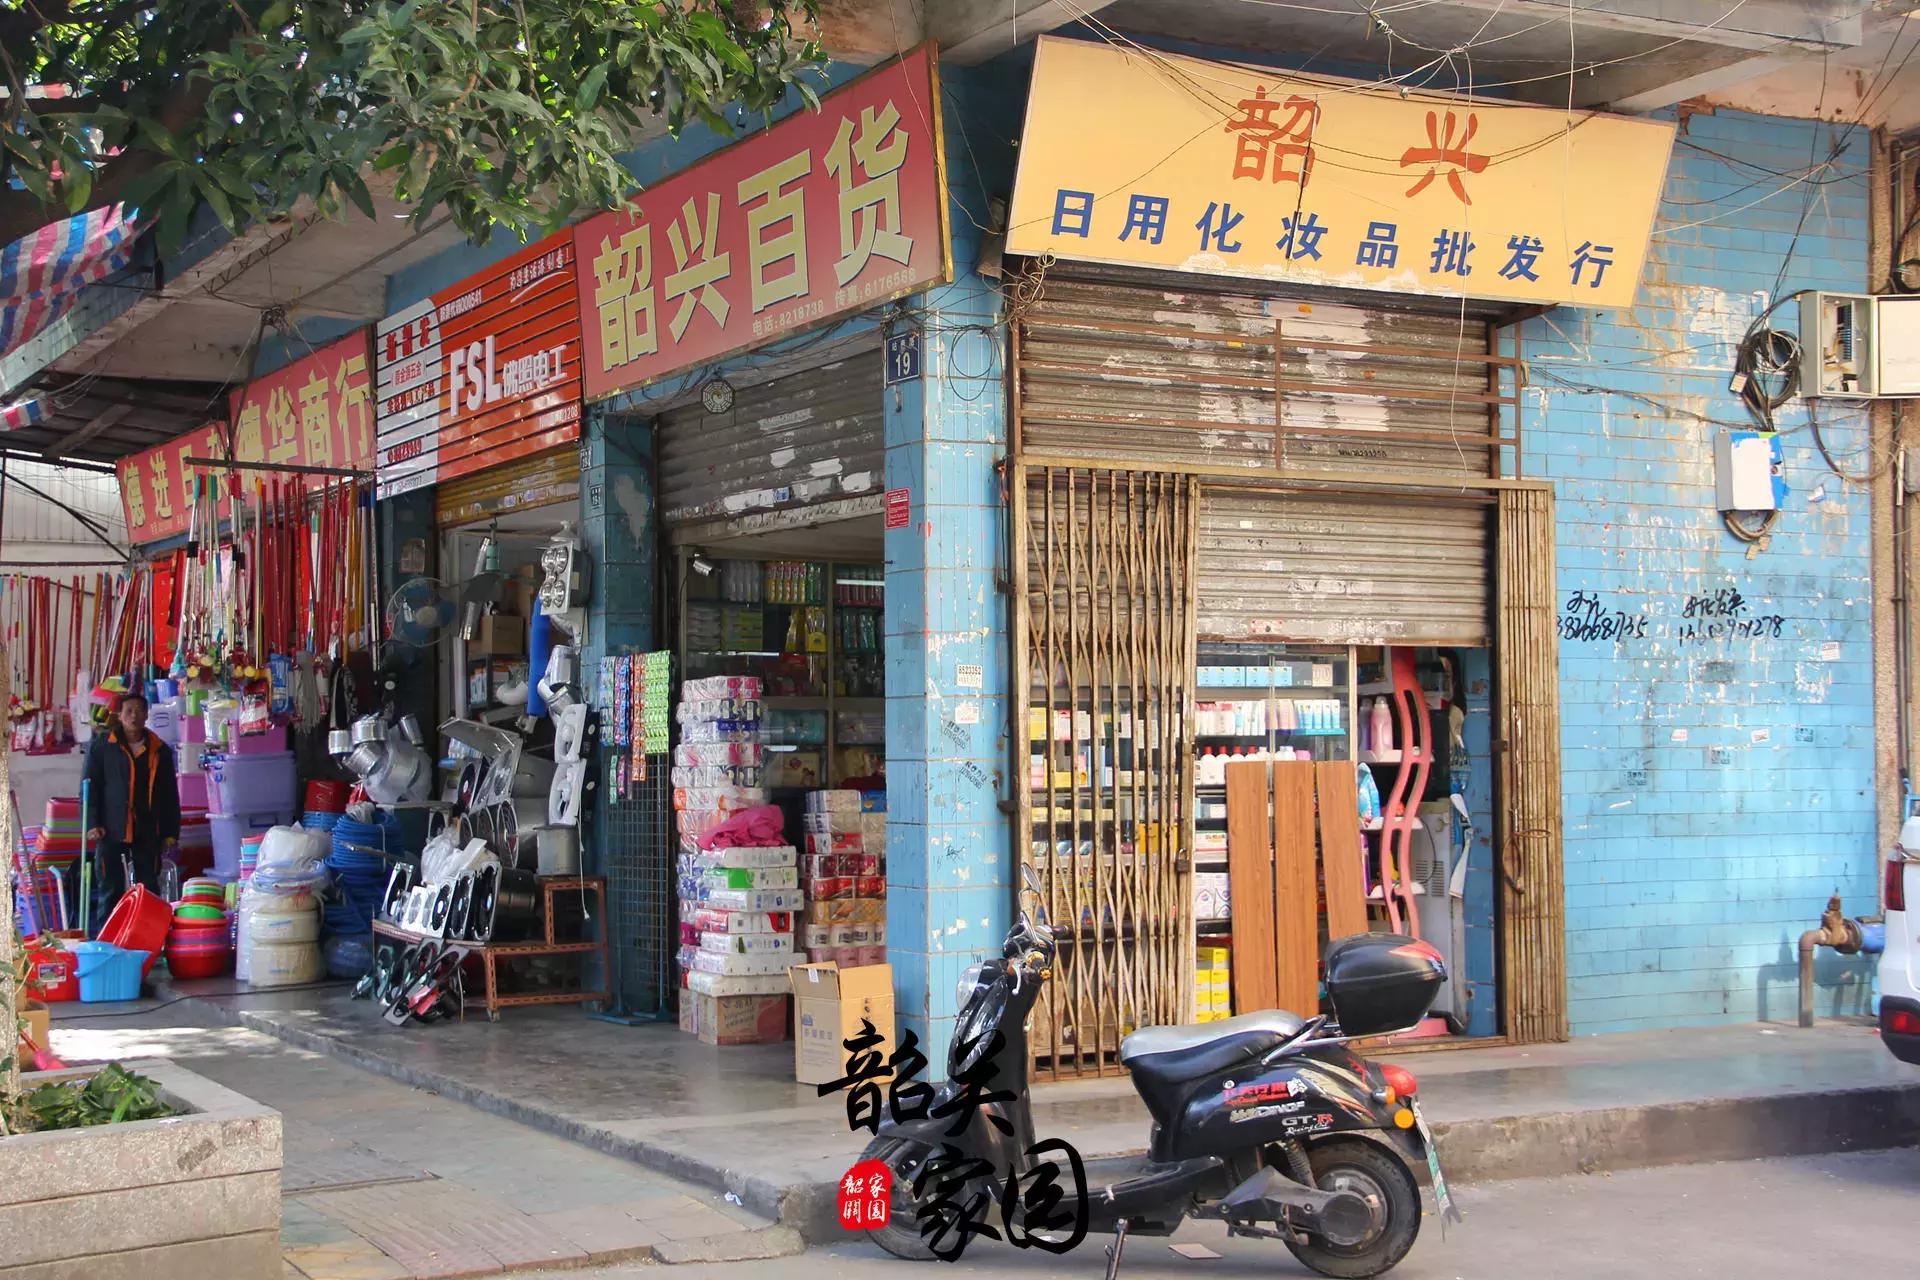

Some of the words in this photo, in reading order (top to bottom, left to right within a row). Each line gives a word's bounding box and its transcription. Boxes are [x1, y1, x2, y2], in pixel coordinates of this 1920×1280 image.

[1224, 85, 1491, 206] 韶兴
[593, 99, 914, 372] 韶兴百货
[1050, 188, 1614, 289] 日用化妆品批发行
[451, 334, 503, 418] FSL
[503, 344, 568, 399] 佛照电工
[896, 353, 911, 378] 19
